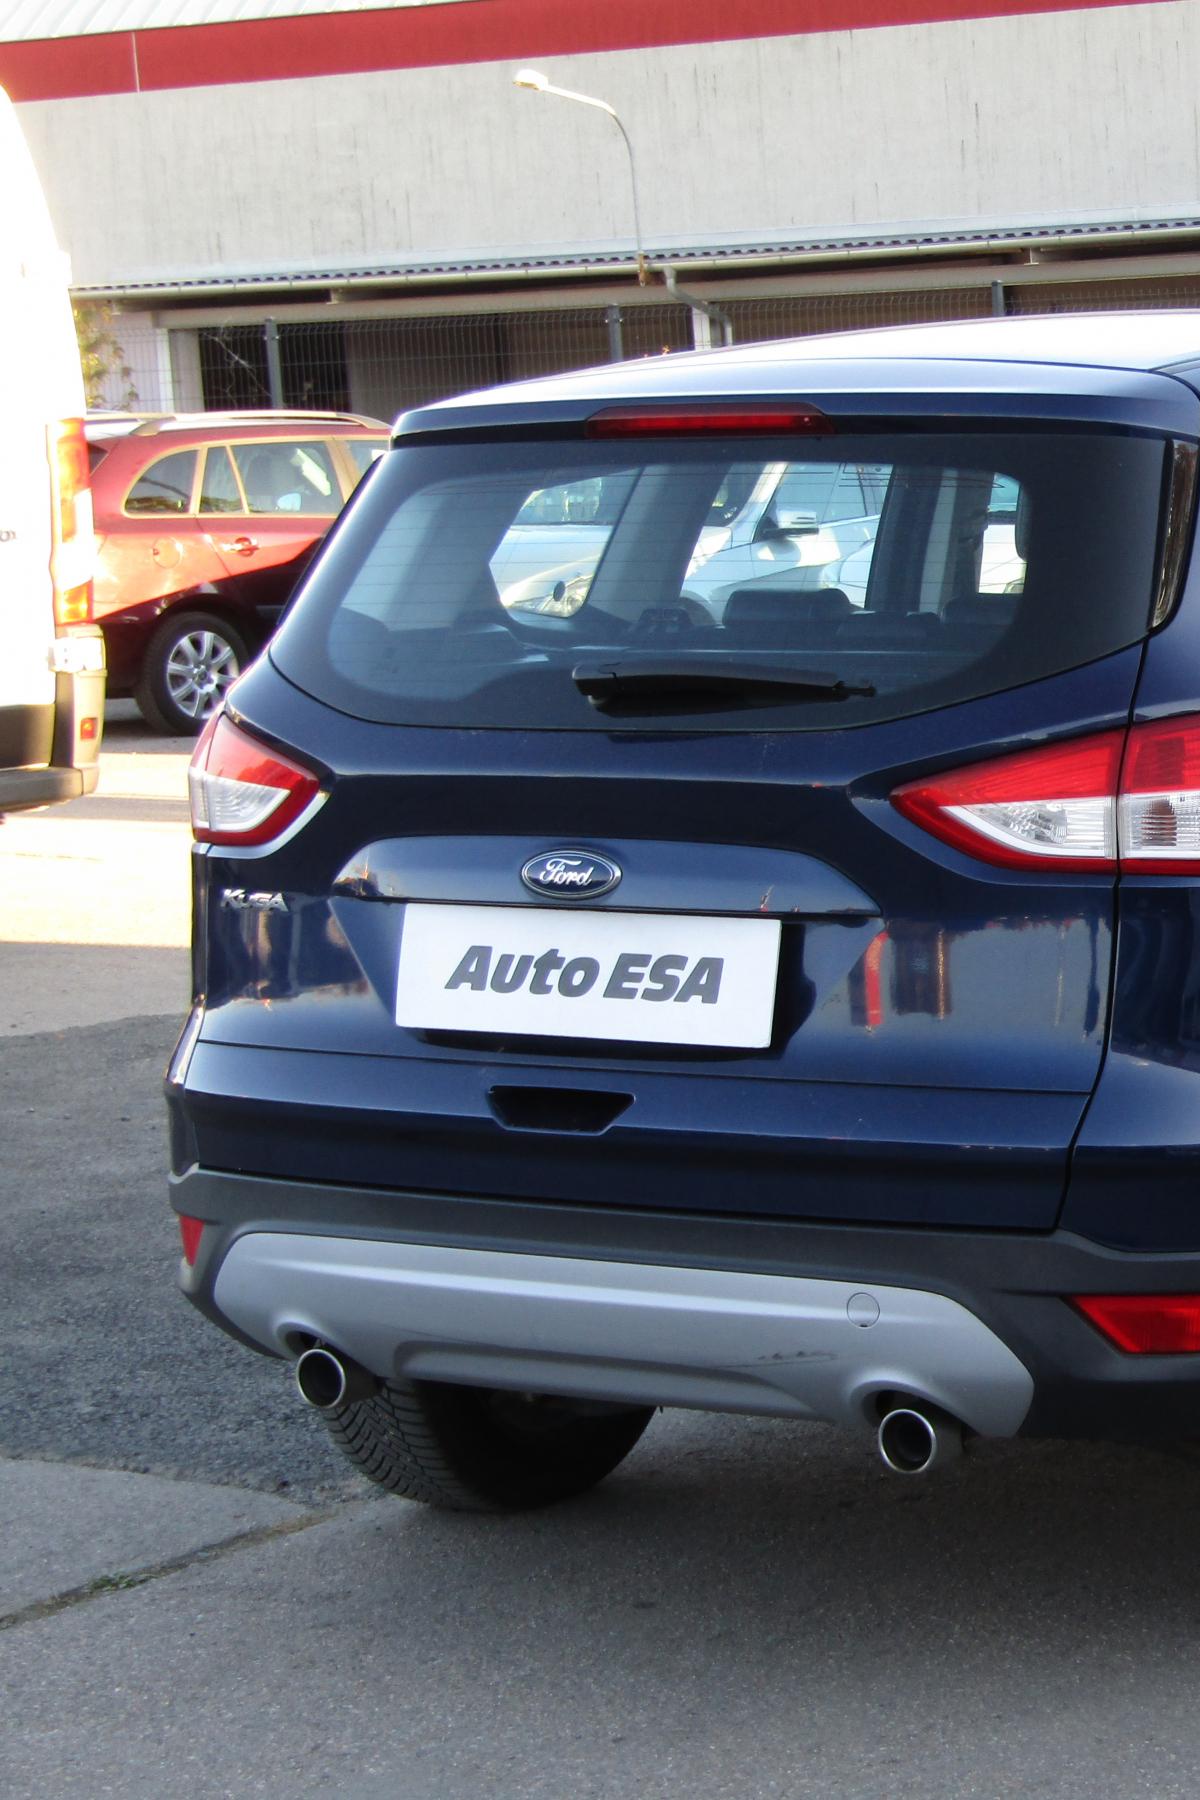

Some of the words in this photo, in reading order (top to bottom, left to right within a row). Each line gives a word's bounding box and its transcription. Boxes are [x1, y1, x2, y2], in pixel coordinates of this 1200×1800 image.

[540, 858, 594, 886] Ford
[220, 888, 289, 912] KUGA
[444, 945, 600, 998] Auto
[603, 952, 724, 1004] ESA
